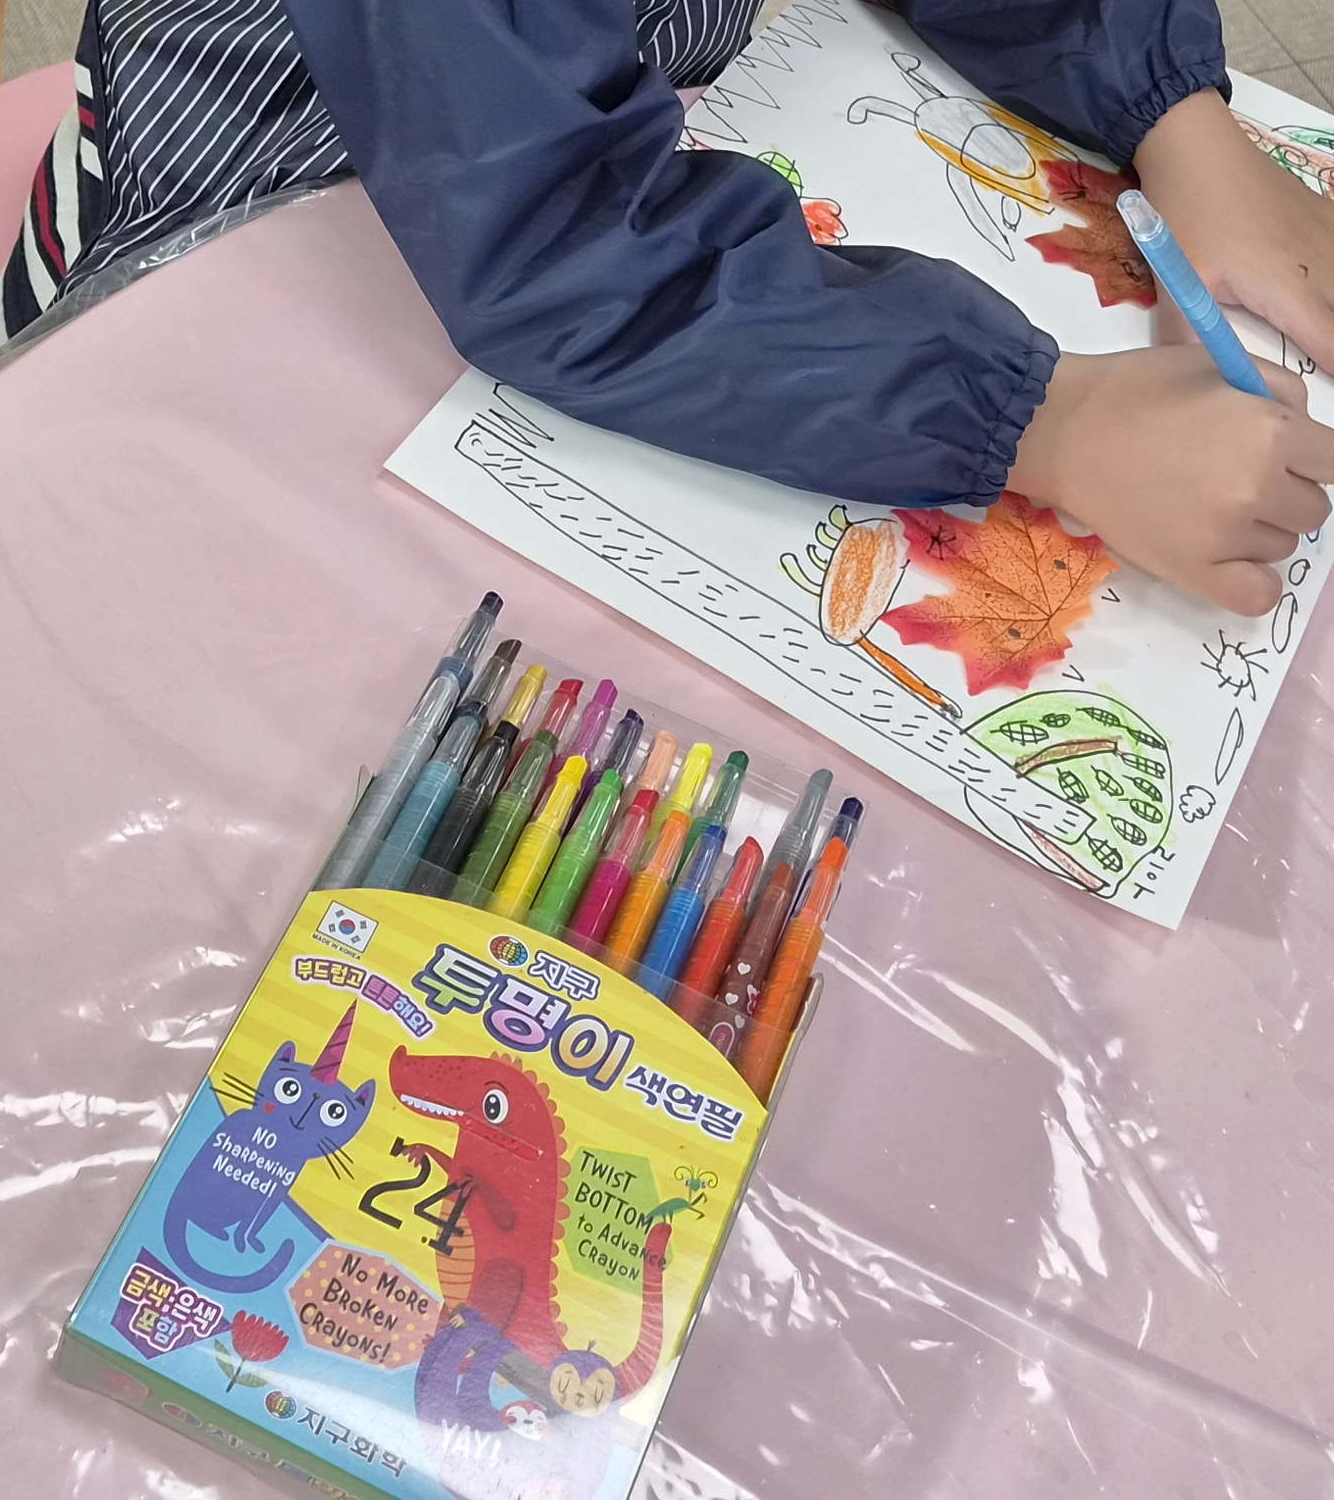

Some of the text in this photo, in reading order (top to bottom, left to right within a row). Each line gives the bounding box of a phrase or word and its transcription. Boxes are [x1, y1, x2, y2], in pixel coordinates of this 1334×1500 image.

[312, 933, 330, 946] MADE
[339, 946, 361, 961] KOREA
[297, 959, 365, 987] 부드럽고
[531, 953, 599, 999] 지구
[413, 945, 634, 1090] 투명이
[625, 1066, 742, 1139] 색연필
[252, 1126, 277, 1149] NO
[212, 1155, 277, 1197] Needed!
[580, 1150, 637, 1193] TWIST
[575, 1182, 654, 1235] BOTTOM
[577, 1213, 667, 1271] to Advance
[578, 1239, 640, 1281] Crayon
[341, 1253, 368, 1282] No
[137, 1307, 178, 1344] 포함
[297, 1407, 407, 1478] 지구화학
[441, 1418, 502, 1468] YAY!
